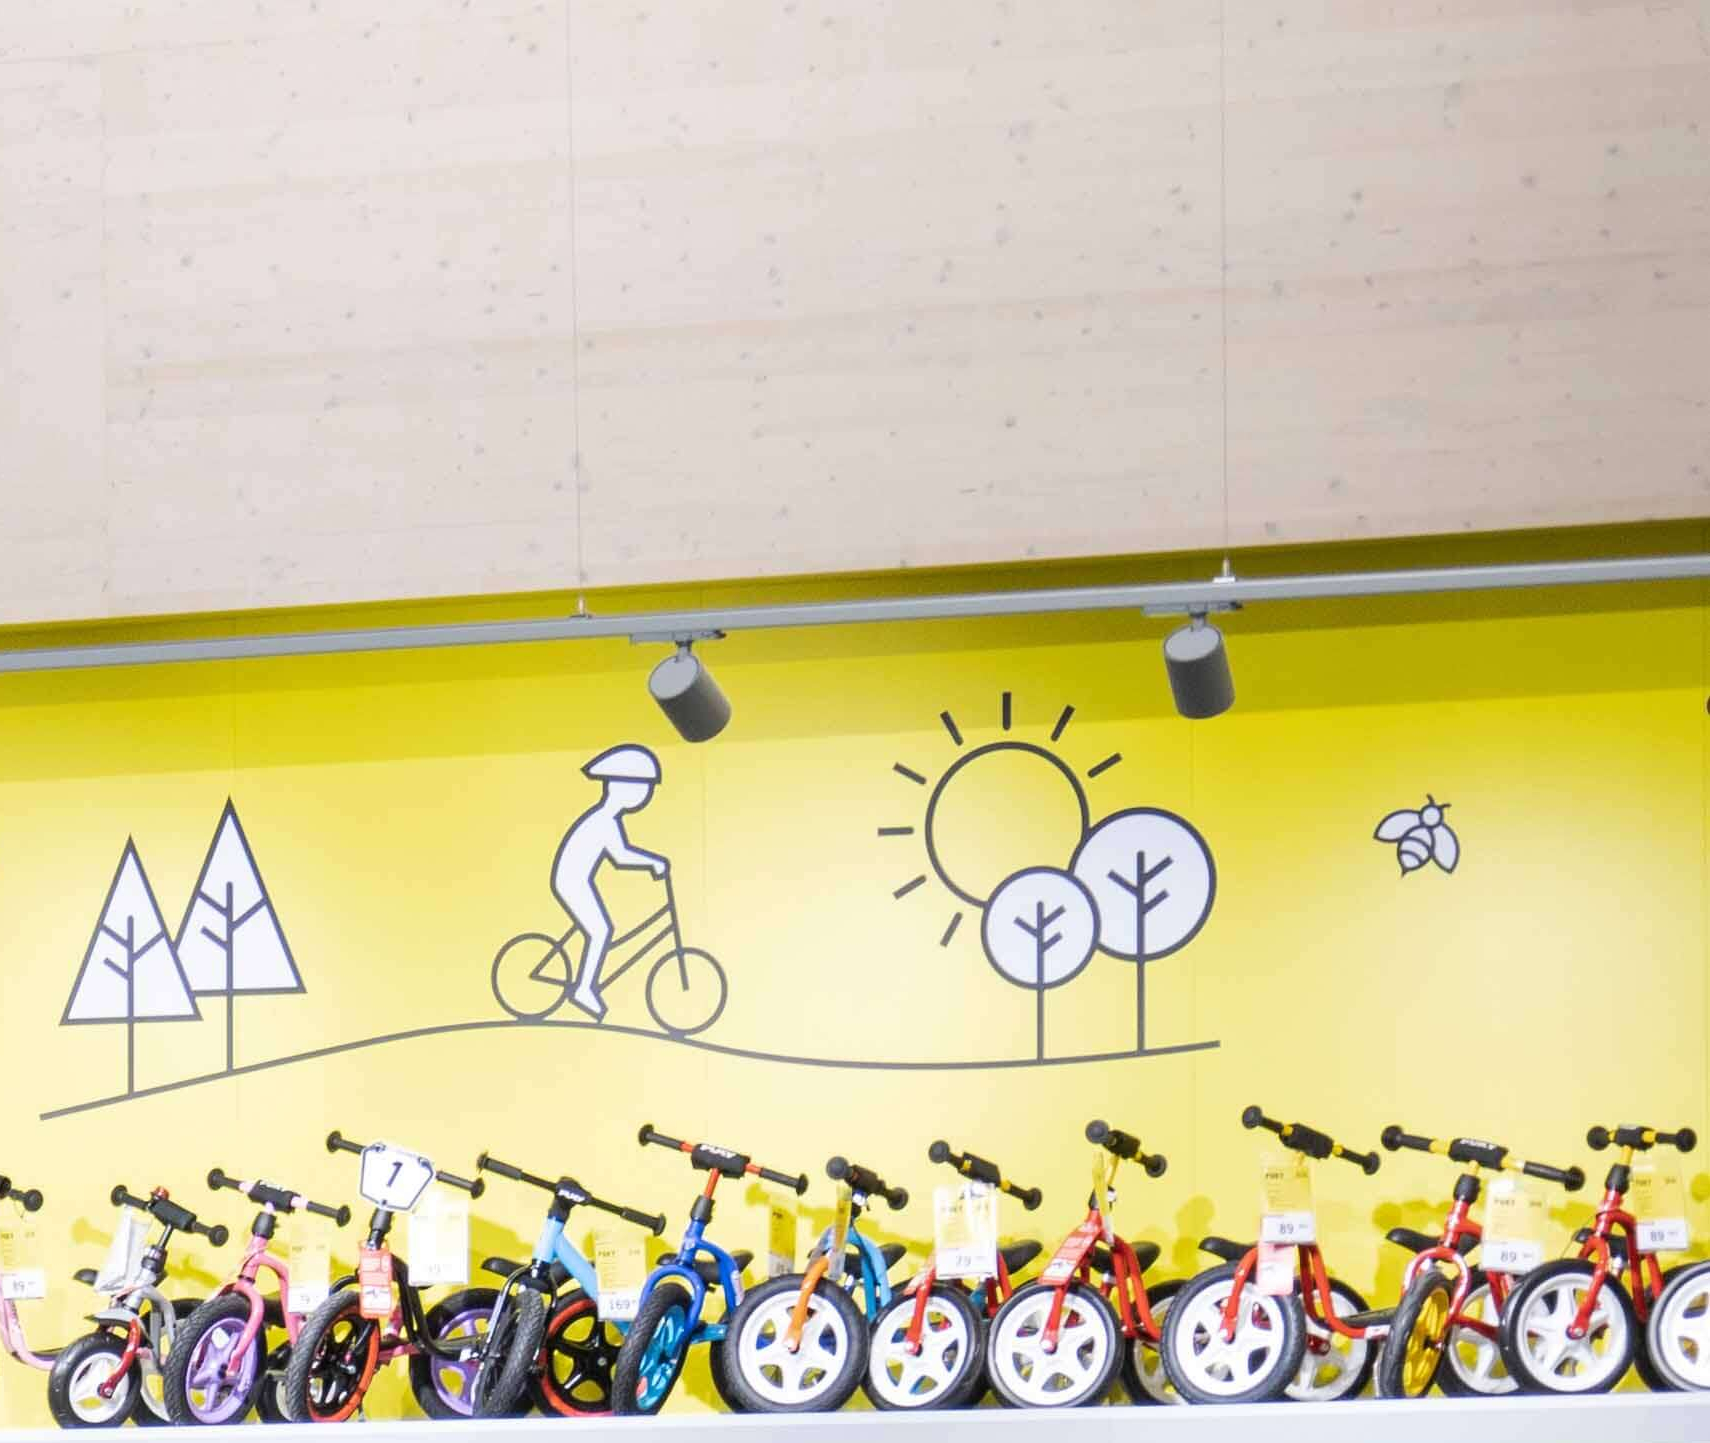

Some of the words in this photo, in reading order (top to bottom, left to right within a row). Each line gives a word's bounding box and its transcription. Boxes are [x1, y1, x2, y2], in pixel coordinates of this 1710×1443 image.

[386, 1162, 403, 1187] 1
[1279, 1223, 1294, 1235] 89
[1649, 1230, 1665, 1242] 89
[1500, 1251, 1517, 1263] 89
